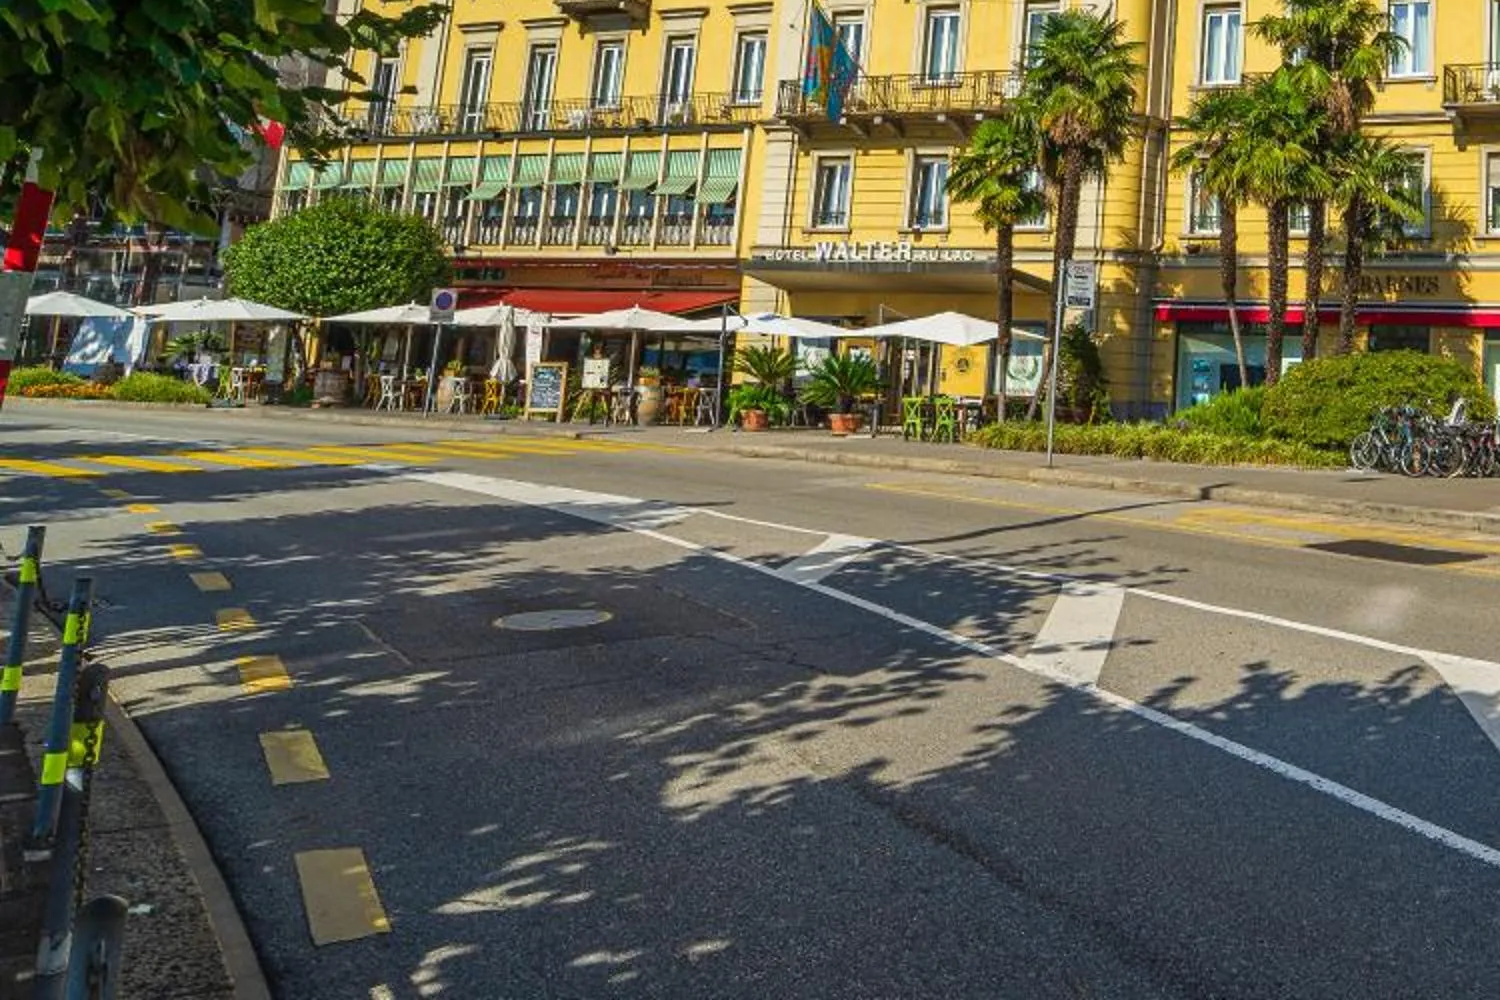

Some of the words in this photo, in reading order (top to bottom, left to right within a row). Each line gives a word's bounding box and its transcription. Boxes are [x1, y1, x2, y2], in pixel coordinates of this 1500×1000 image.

[766, 250, 808, 261] HOTEL
[815, 241, 912, 262] WALTER
[921, 250, 941, 261] AU
